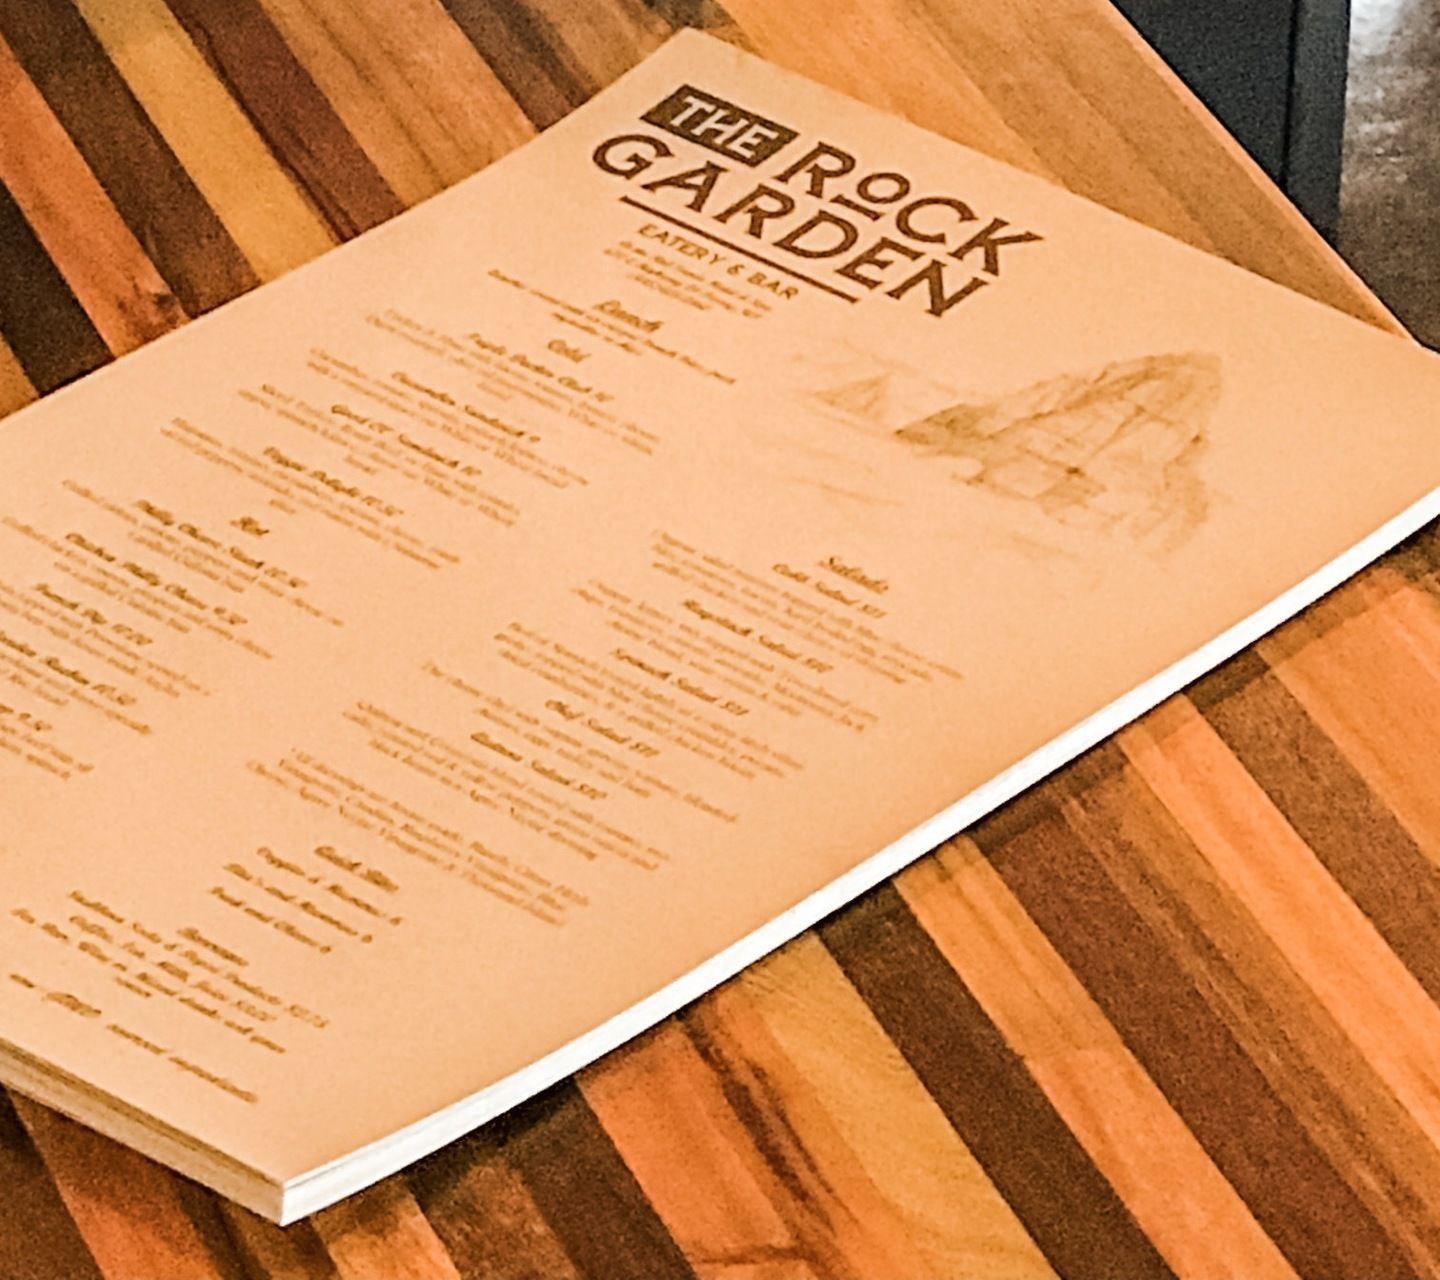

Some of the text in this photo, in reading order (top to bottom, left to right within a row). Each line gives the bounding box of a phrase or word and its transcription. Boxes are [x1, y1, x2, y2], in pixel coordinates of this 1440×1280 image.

[591, 132, 989, 318] GARDEN
[636, 222, 725, 267] EATERY
[727, 258, 748, 277] &
[747, 271, 800, 303] BAR
[663, 91, 1045, 277] THE ROCK
